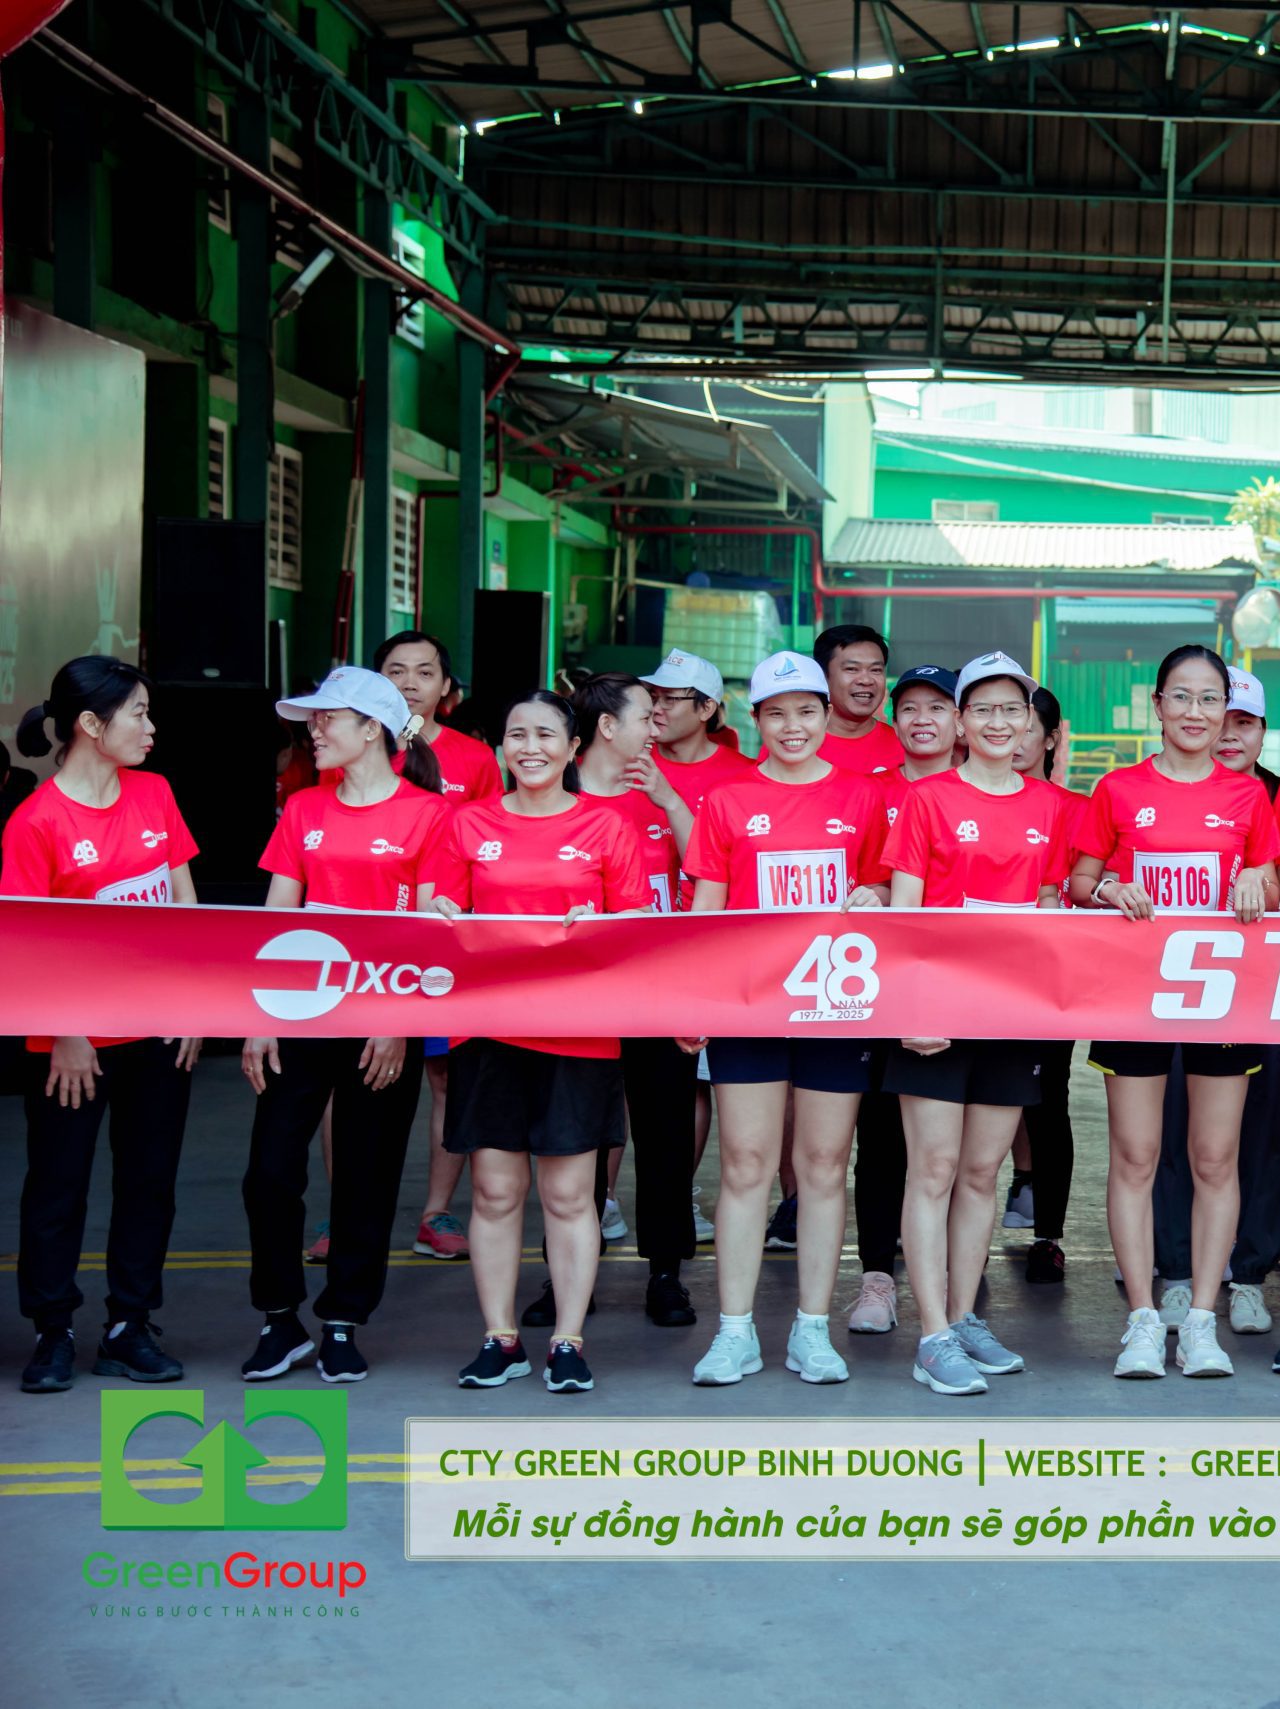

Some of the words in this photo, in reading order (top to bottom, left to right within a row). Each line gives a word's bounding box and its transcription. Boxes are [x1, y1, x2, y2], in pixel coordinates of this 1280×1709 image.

[746, 813, 771, 832] 48
[1135, 806, 1156, 824] 48
[303, 829, 324, 847] 48
[956, 820, 979, 839] 48
[73, 839, 98, 863] 48
[477, 841, 502, 858] 48
[768, 862, 837, 907] W3113
[1141, 865, 1211, 907] W3106
[782, 932, 880, 1011] 48
[800, 1011, 824, 1020] 1977
[836, 1009, 864, 1019] 2025
